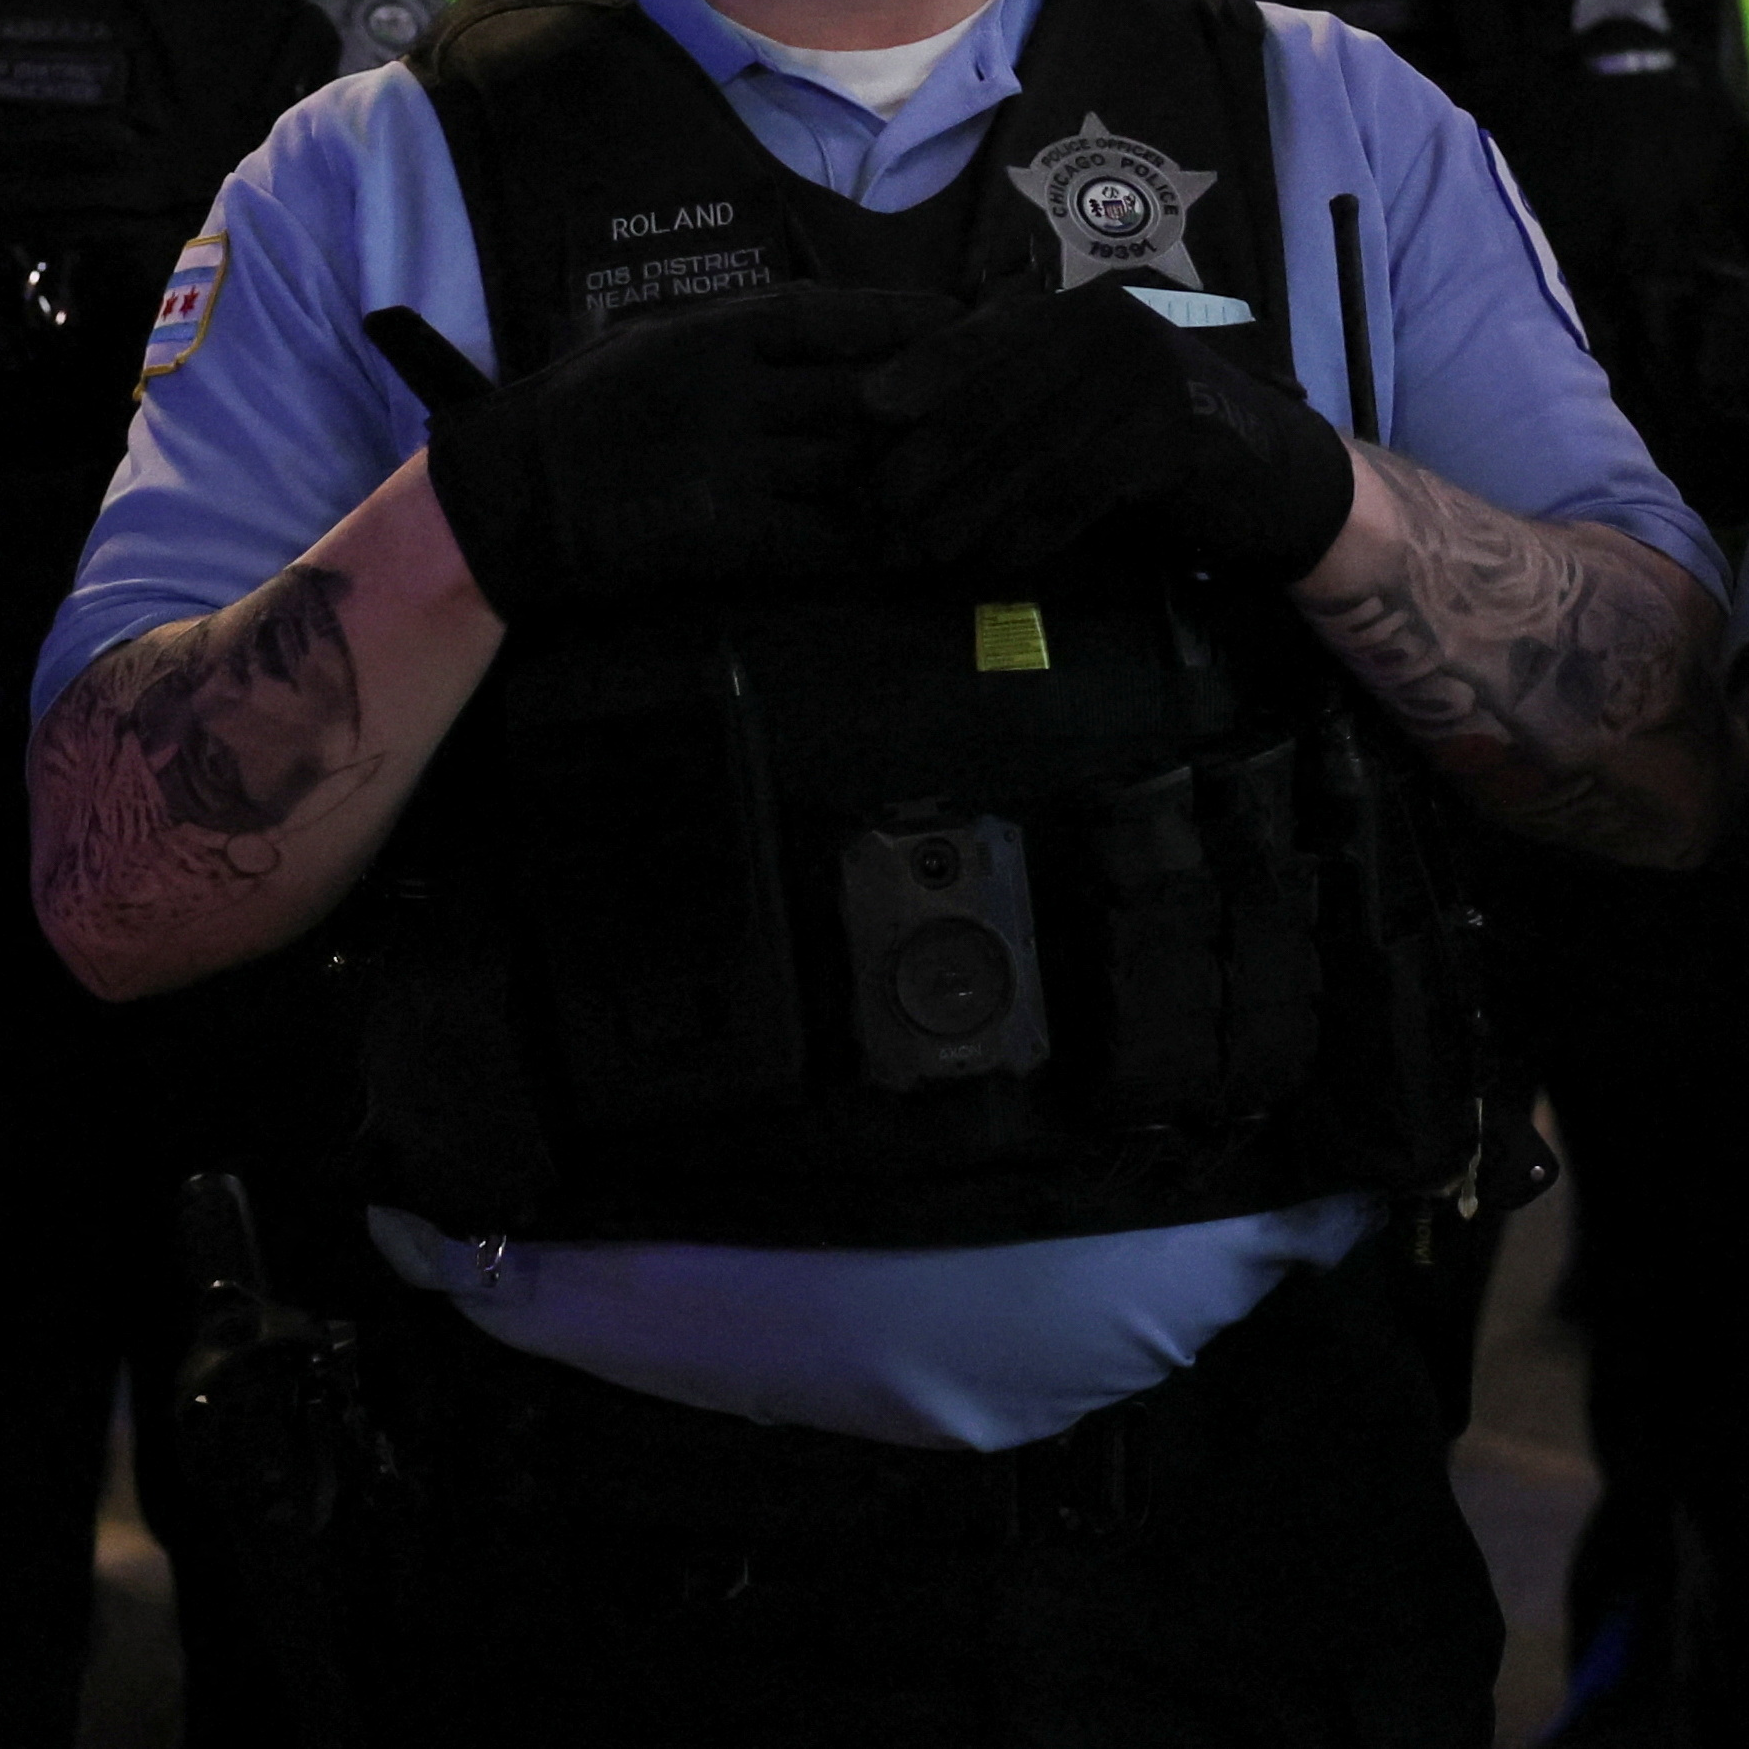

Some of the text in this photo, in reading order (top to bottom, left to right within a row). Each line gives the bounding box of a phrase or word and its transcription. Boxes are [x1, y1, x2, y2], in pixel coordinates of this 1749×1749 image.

[1041, 136, 1166, 169] POLICE OFFICER
[1049, 152, 1180, 218] CHICAGO POLICE
[610, 200, 736, 242] ROLAND
[584, 265, 772, 311] NEAR NORTH
[585, 245, 767, 292] 018 DISTRICT
